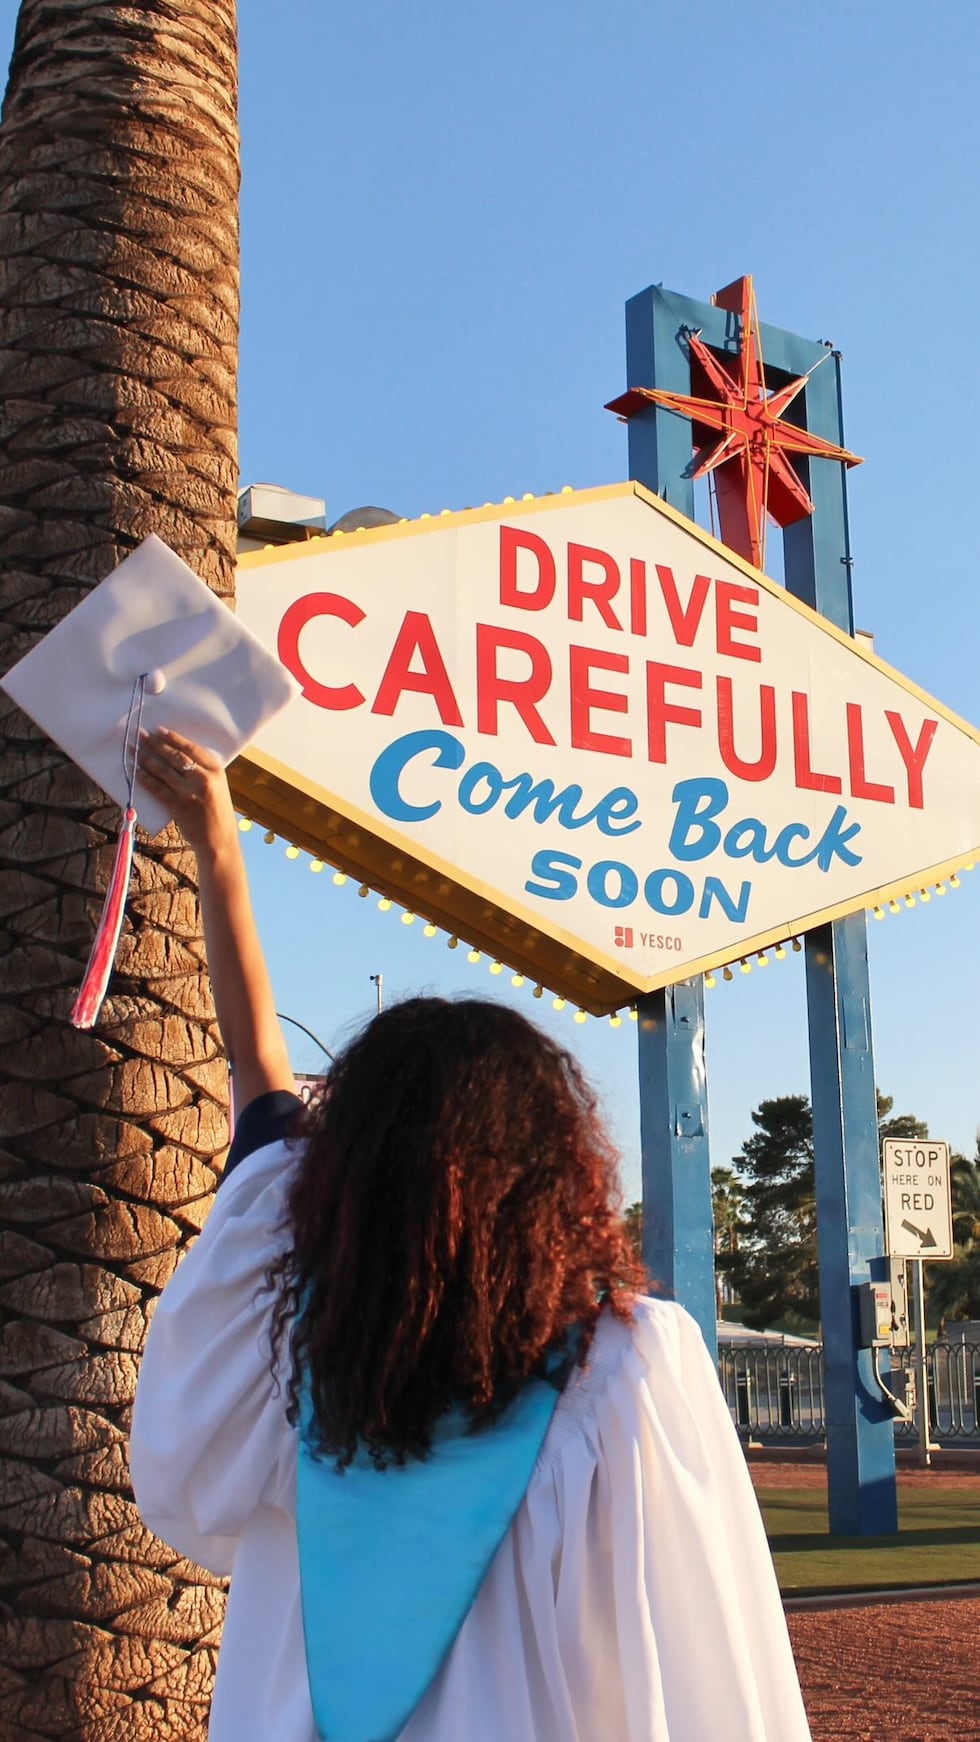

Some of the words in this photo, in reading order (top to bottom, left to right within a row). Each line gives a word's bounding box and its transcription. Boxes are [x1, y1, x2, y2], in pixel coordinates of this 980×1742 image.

[500, 525, 763, 664] DRIVE
[277, 591, 939, 811] CAREFULLY
[369, 729, 641, 837] Come
[669, 777, 863, 873] Back
[525, 850, 752, 923] SOON
[640, 932, 682, 951] YESCO
[892, 1174, 919, 1186] HERE
[927, 1175, 942, 1187] ON
[894, 1149, 938, 1168] STOP
[901, 1193, 934, 1211] RED
